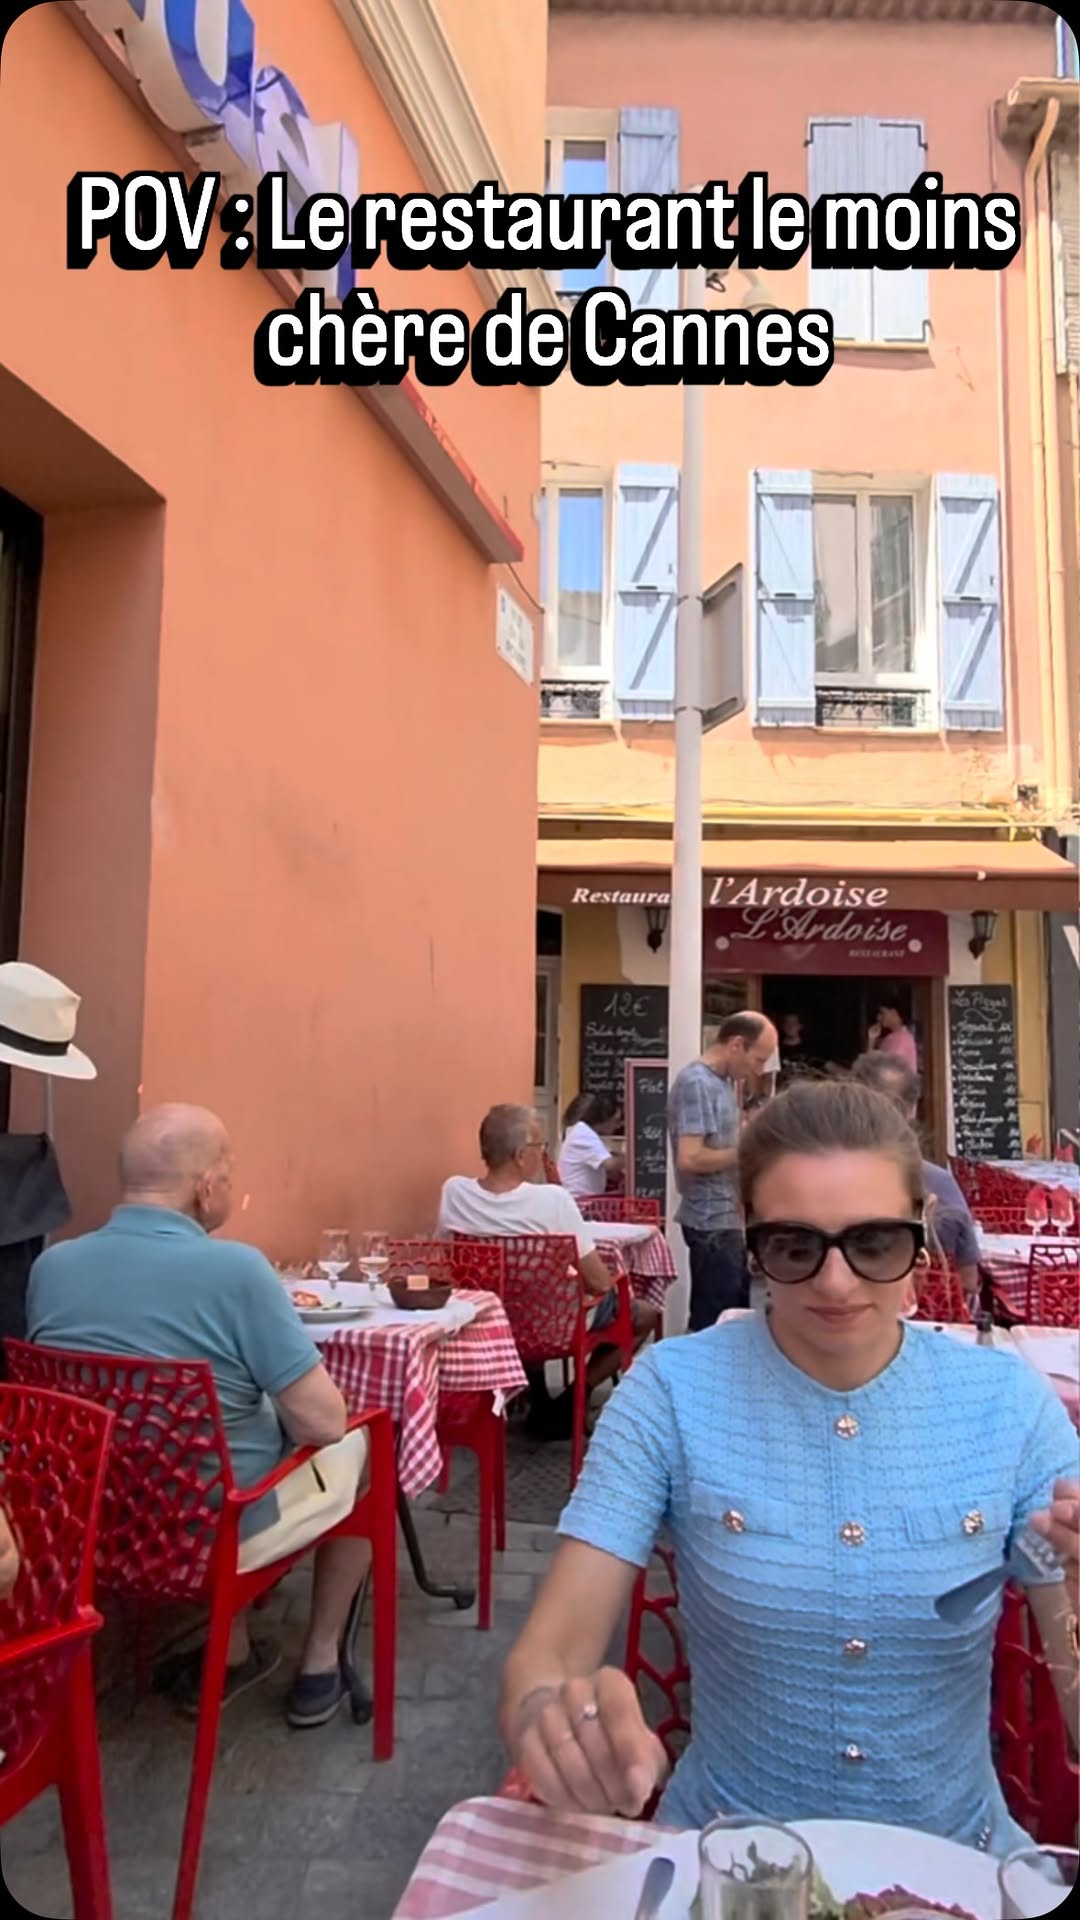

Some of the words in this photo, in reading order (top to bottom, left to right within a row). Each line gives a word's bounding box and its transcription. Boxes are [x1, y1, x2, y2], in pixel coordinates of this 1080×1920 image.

[572, 887, 671, 904] Restaura
[709, 877, 888, 908] l'Ardoise
[730, 906, 908, 942] L'Ardoise
